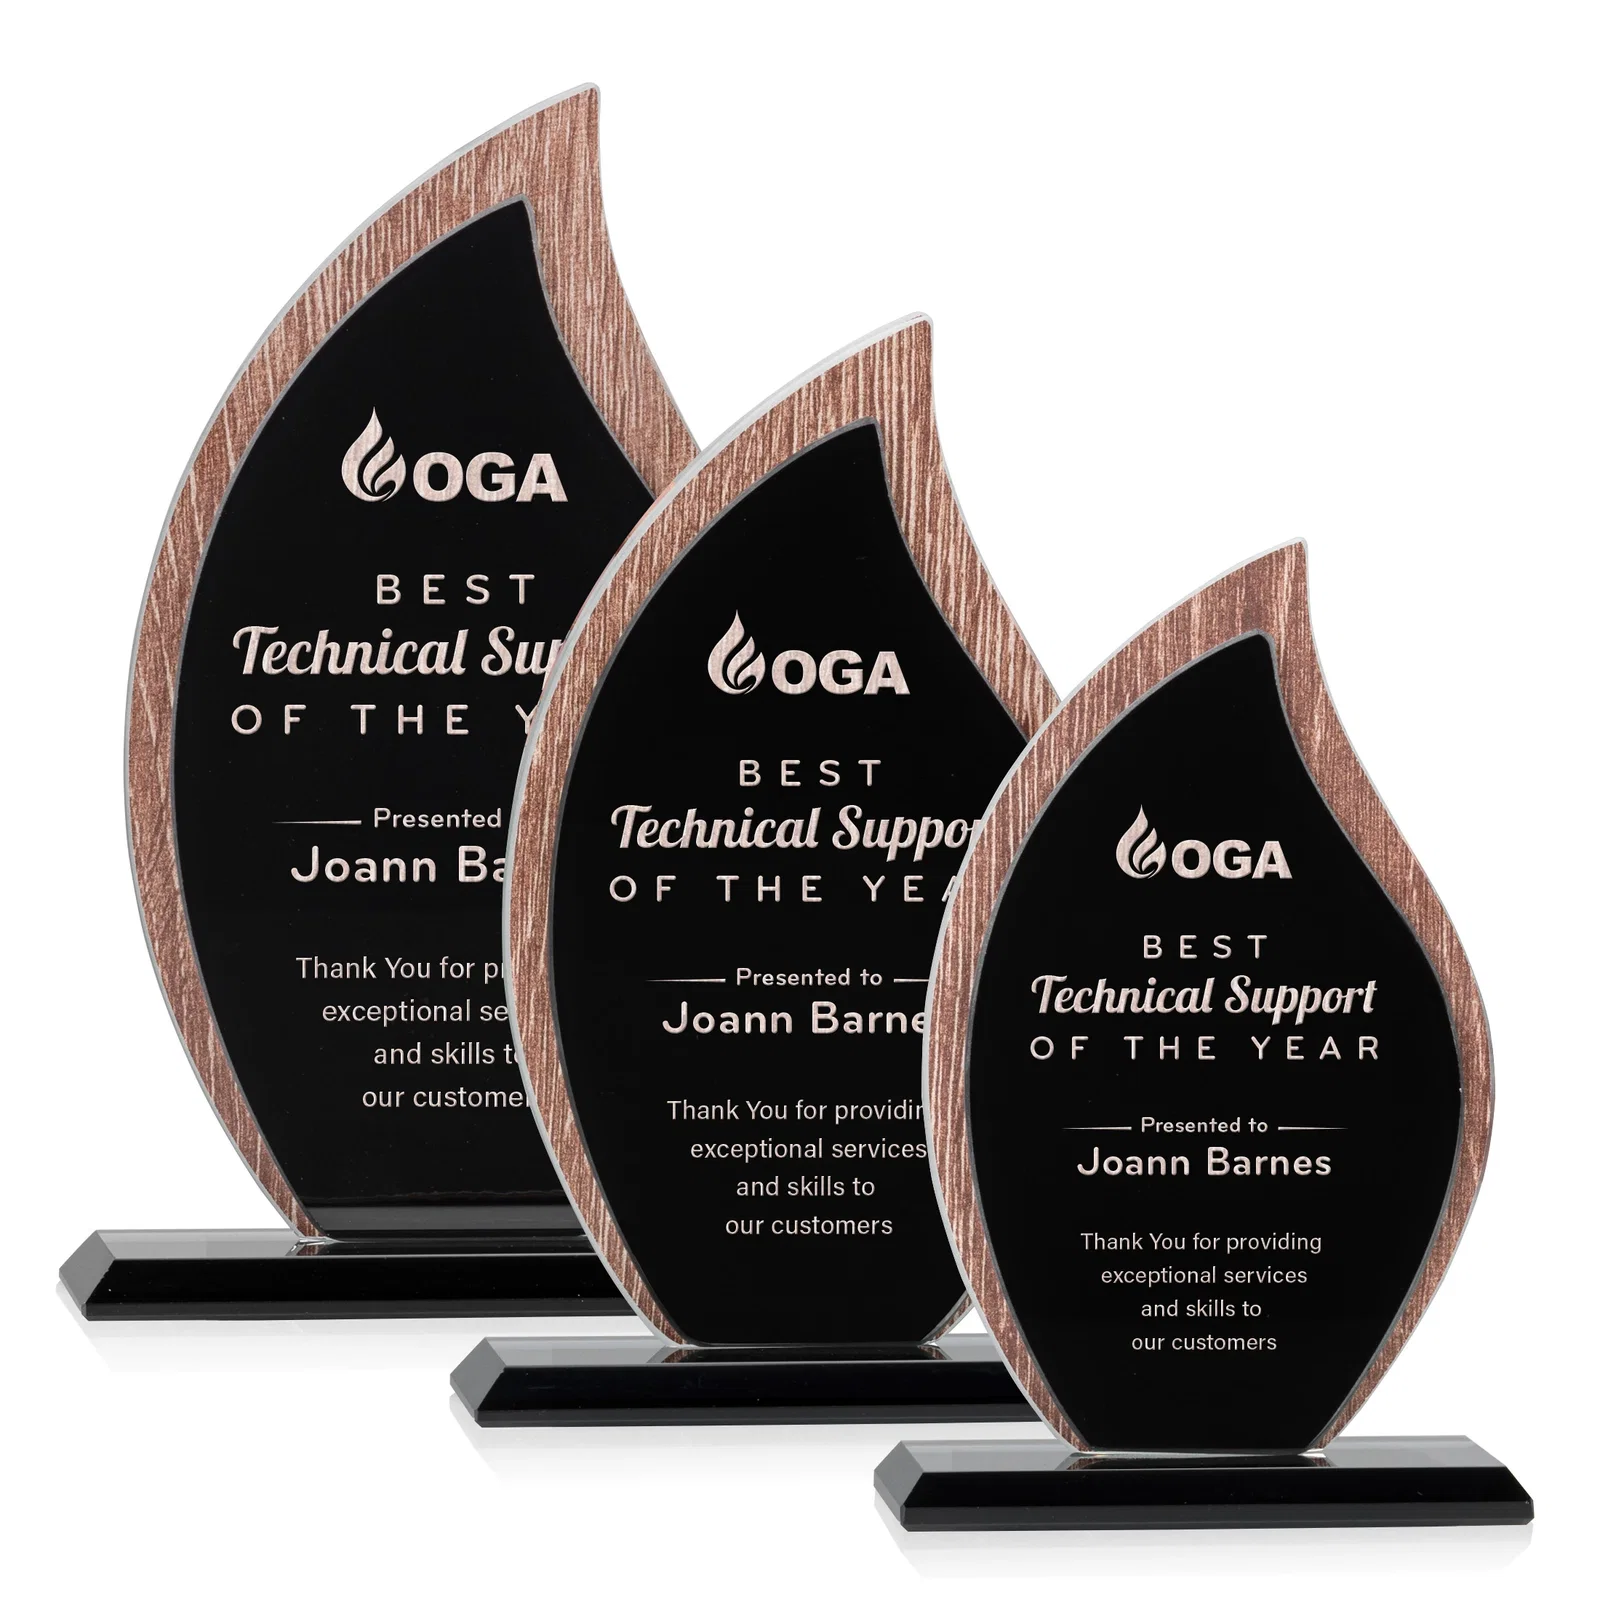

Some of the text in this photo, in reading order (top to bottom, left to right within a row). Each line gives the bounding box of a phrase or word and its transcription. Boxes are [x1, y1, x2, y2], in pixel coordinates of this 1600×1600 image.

[413, 452, 568, 502] OGA
[377, 574, 535, 604] BEST
[233, 626, 469, 675] Technical
[772, 650, 910, 694] OGA
[231, 704, 306, 735] OF
[350, 704, 469, 735] THE
[740, 760, 881, 786] BEST
[374, 808, 501, 828] Presented
[611, 805, 821, 848] Technical
[291, 846, 436, 882] Joann
[1172, 840, 1292, 879] OGA
[610, 875, 676, 902] OF
[716, 875, 822, 902] THE
[1144, 935, 1267, 959] BEST
[296, 956, 504, 984] Thank You for p
[737, 968, 882, 985] Presented to
[1031, 975, 1377, 1025] Technical Support
[323, 999, 470, 1027] exceptional
[662, 1001, 792, 1034] Joann
[374, 1042, 518, 1064] and skills t
[1030, 1036, 1378, 1060] OF THE YEAR
[363, 1091, 404, 1107] our
[667, 1099, 739, 1119] Thank
[746, 1101, 787, 1119] You
[796, 1099, 827, 1119] for
[1142, 1117, 1268, 1132] Presented to
[691, 1138, 927, 1163] exceptional services
[1077, 1147, 1331, 1175] Joann Barnes
[737, 1176, 875, 1196] and skills to
[726, 1216, 892, 1234] our customers
[1081, 1232, 1321, 1254] Thank You for providing
[1102, 1266, 1307, 1287] exceptional services
[1142, 1299, 1261, 1316] and skills to
[1132, 1335, 1276, 1350] our customers
